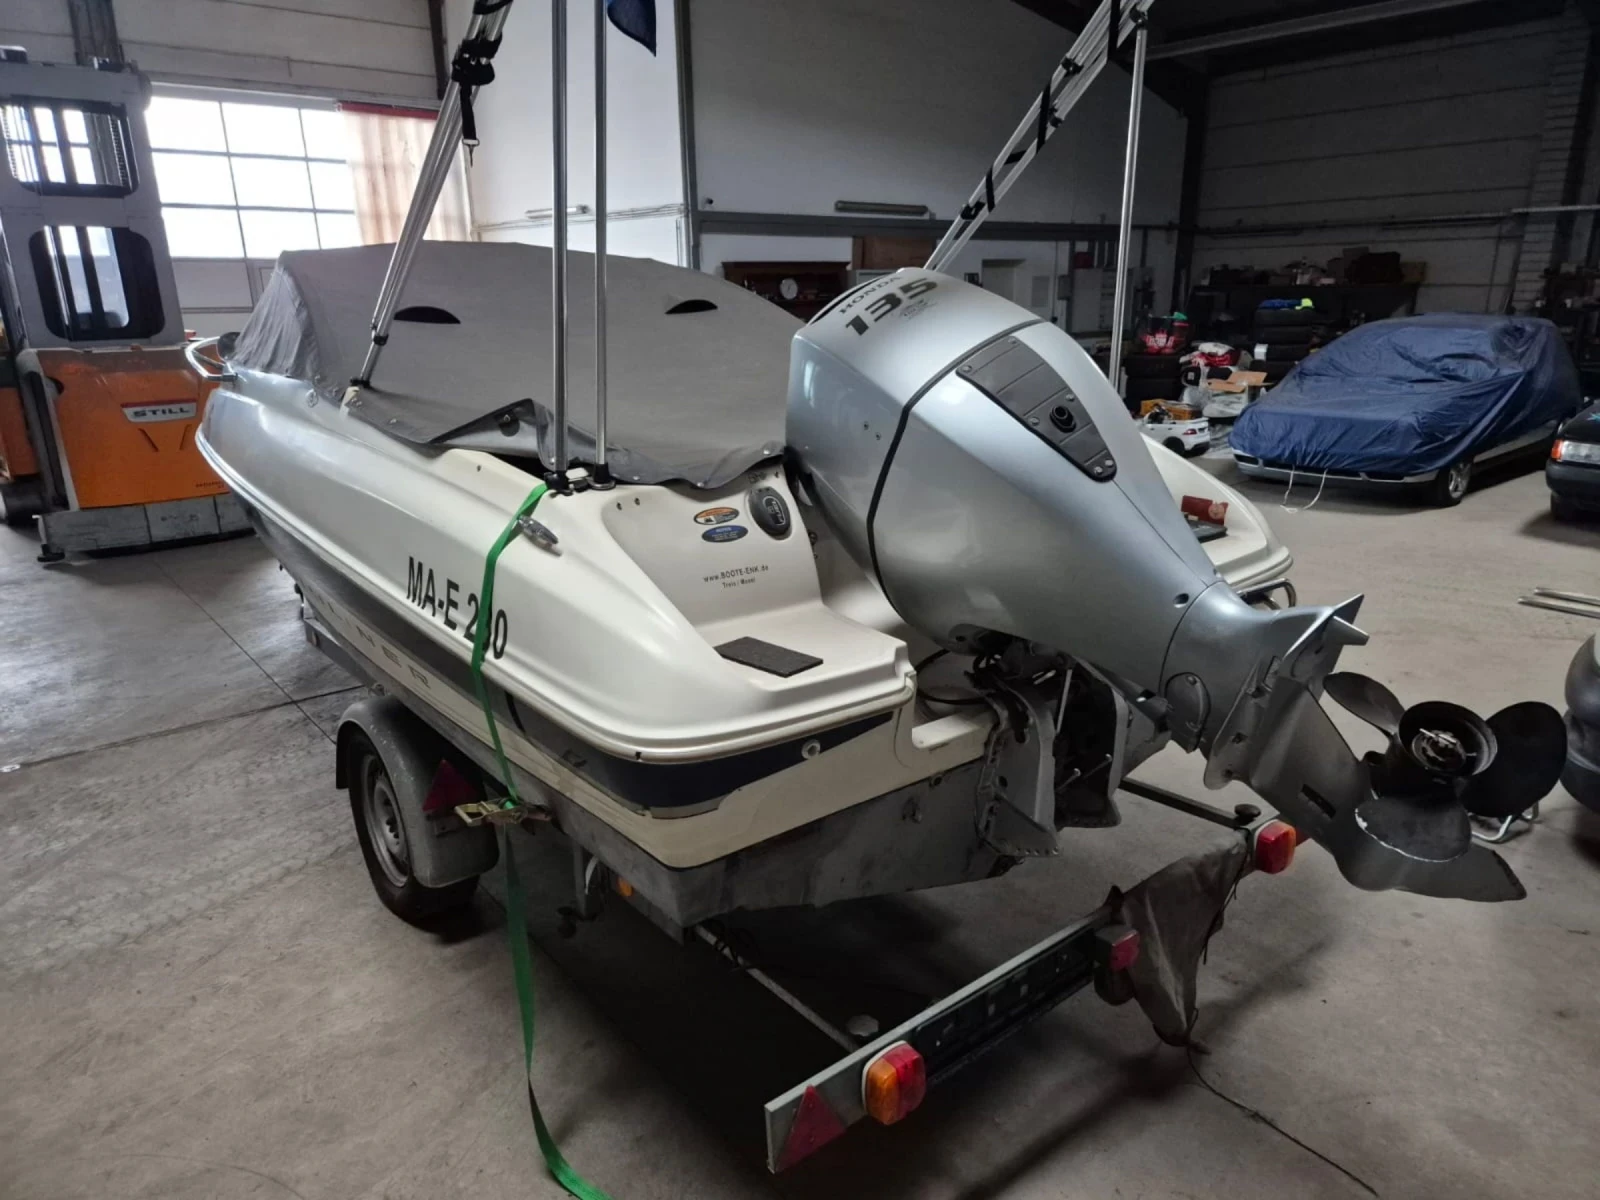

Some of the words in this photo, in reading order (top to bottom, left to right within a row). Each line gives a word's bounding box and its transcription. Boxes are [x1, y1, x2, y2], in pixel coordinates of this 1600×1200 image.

[839, 277, 903, 314] HONDA
[845, 277, 938, 337] 135
[133, 407, 190, 418] STILL
[406, 555, 460, 632] MA-E
[463, 592, 508, 660] 20
